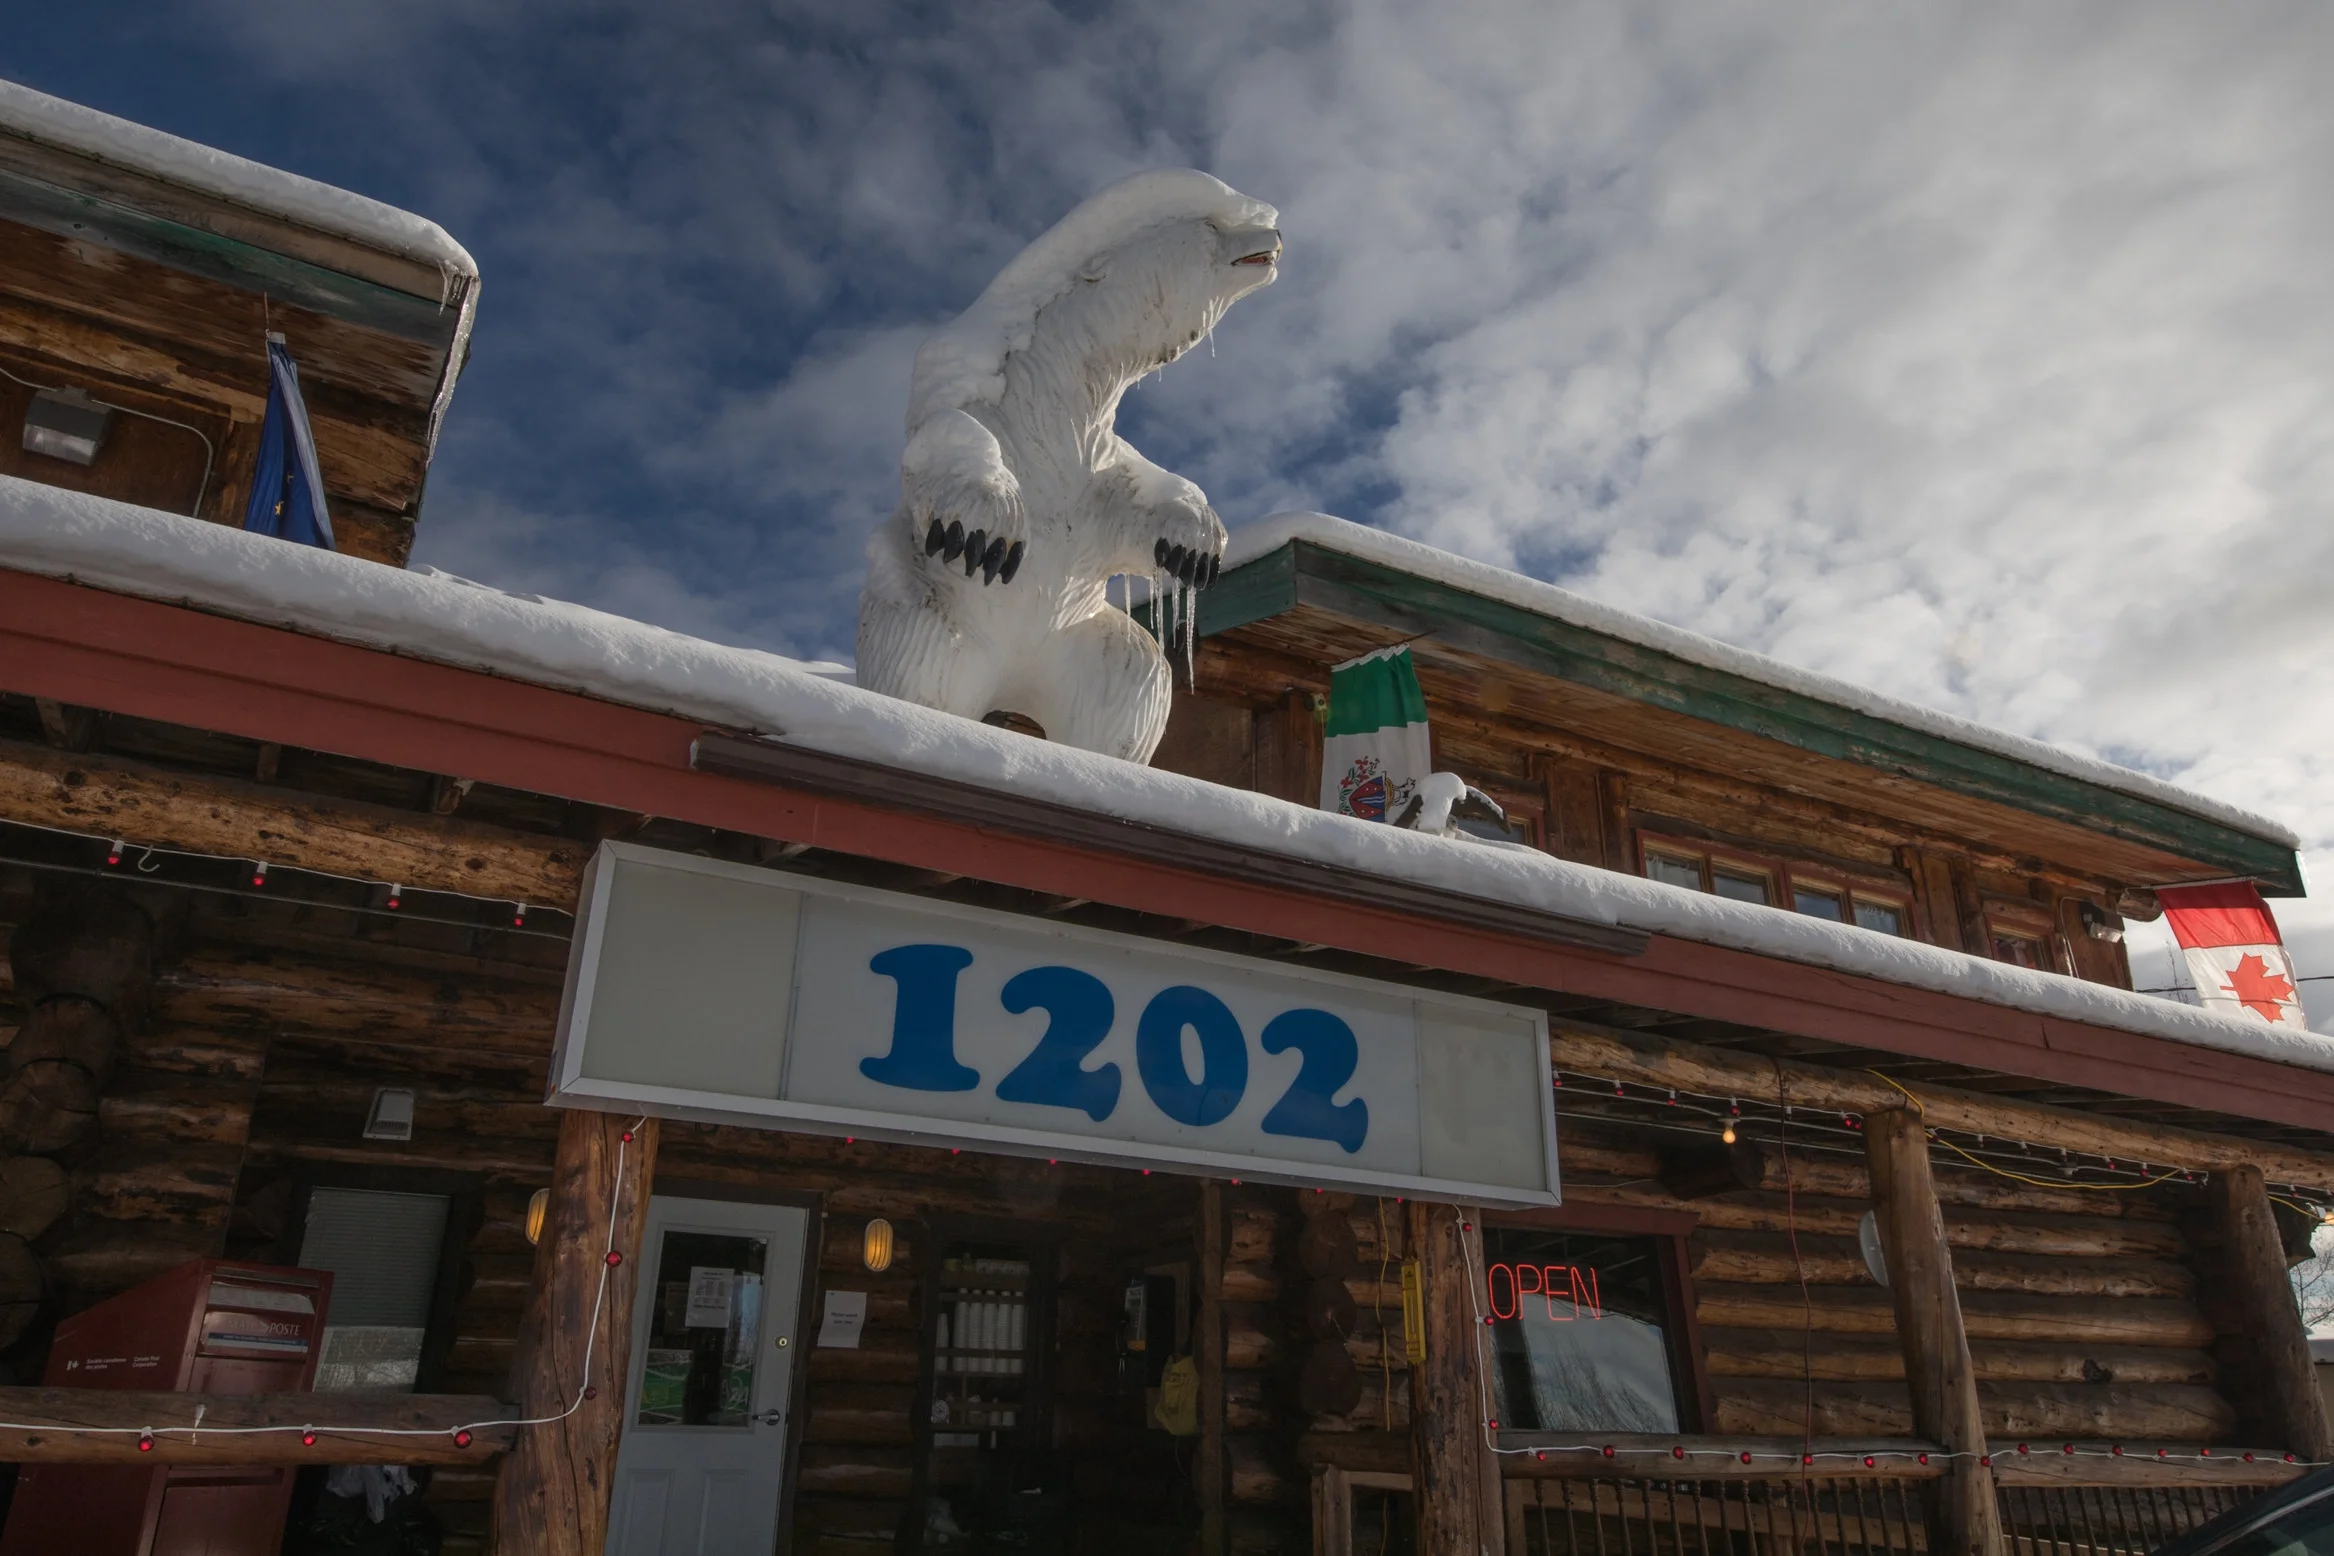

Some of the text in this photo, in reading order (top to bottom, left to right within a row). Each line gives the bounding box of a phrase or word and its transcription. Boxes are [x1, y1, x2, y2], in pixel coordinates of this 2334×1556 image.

[859, 943, 1369, 1154] 1202
[1488, 1263, 1601, 1321] OPEN
[269, 1321, 301, 1336] POSTE
